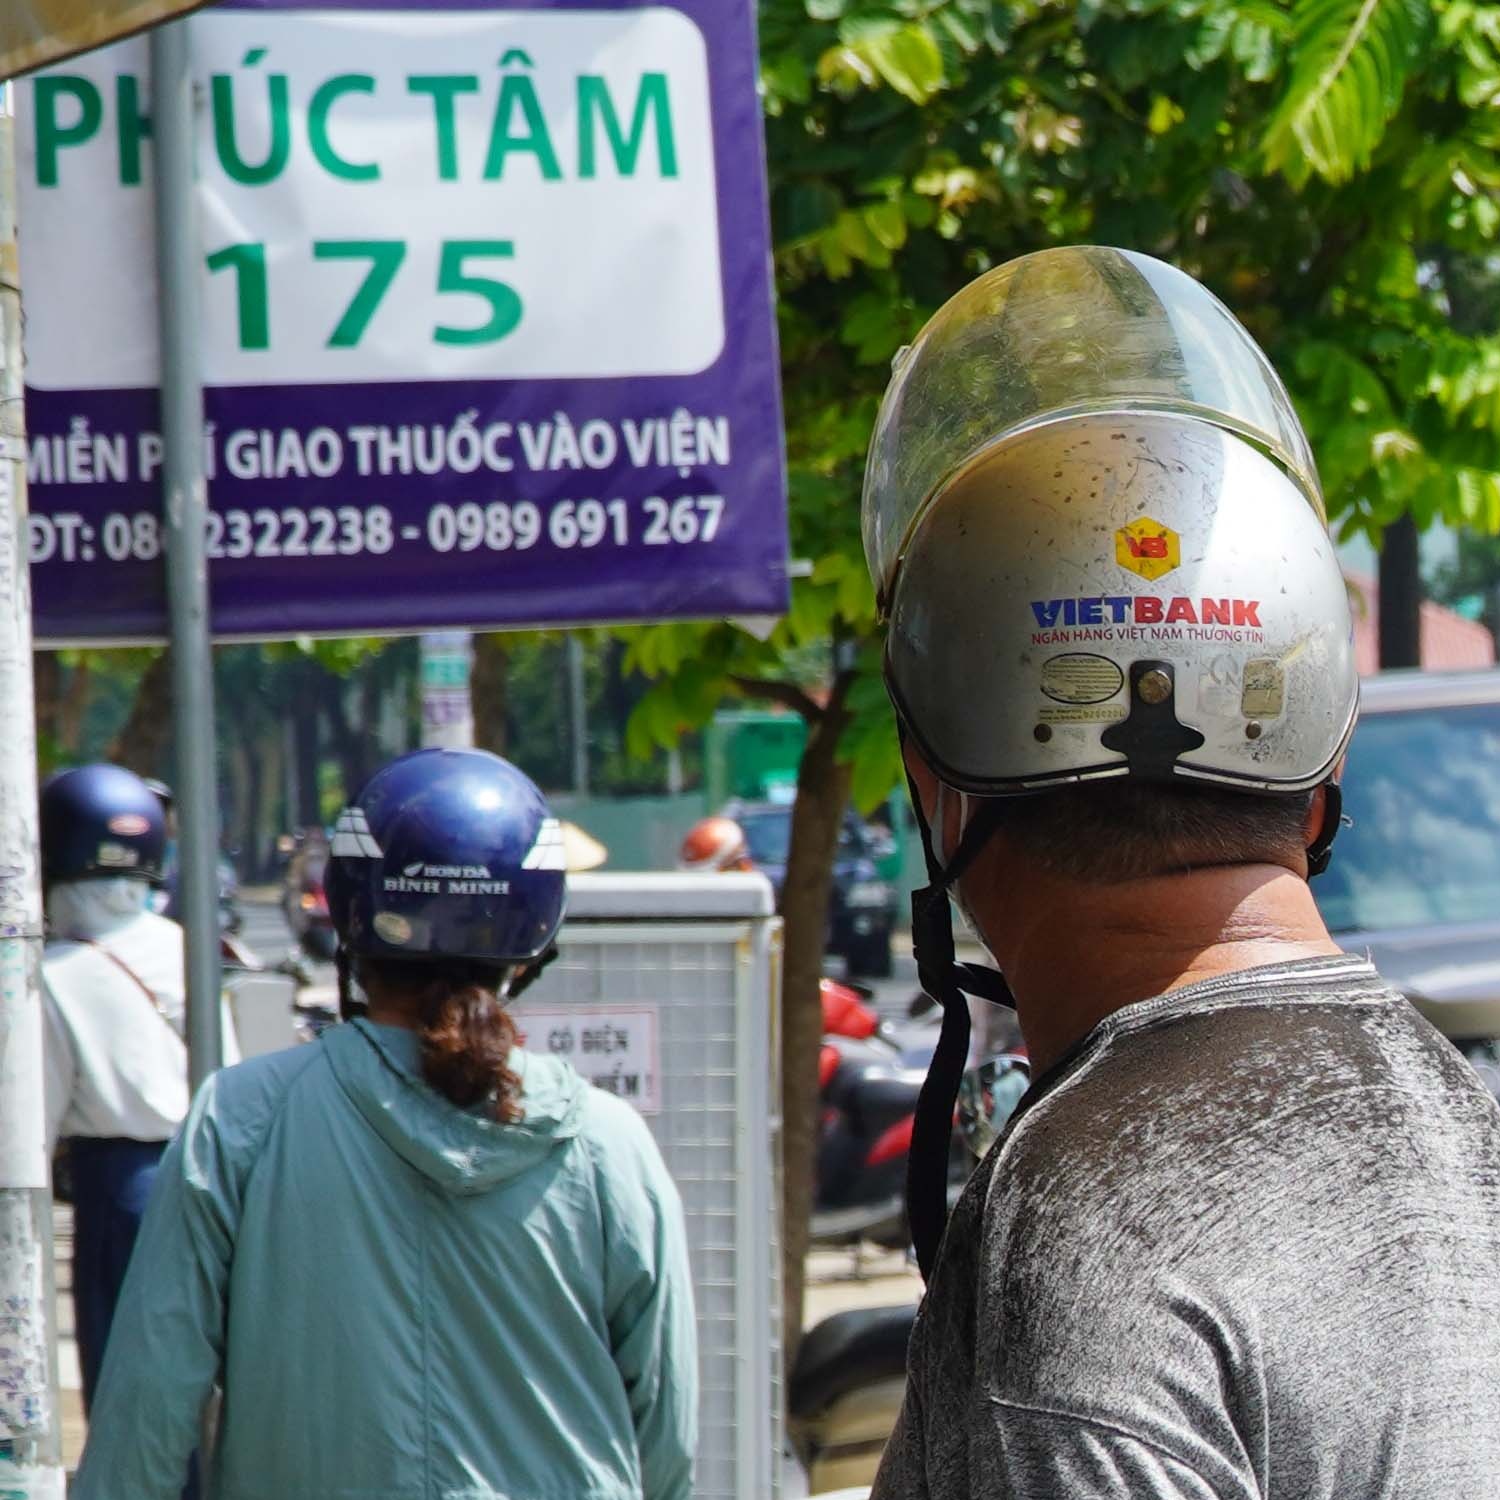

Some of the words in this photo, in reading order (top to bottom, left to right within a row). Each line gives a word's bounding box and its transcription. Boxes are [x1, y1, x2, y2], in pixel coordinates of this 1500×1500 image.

[406, 50, 679, 182] TÂM
[206, 240, 524, 351] 175
[138, 421, 216, 482] PÍ
[225, 427, 344, 479] GIAO
[347, 408, 514, 476] THUỐC
[517, 410, 617, 471] VÀO
[621, 406, 730, 478] VIỆN
[427, 501, 541, 552] 0989
[550, 498, 628, 548] 691
[642, 495, 725, 545] 267
[1030, 596, 1262, 628] VIETBANK
[1032, 629, 1070, 645] NGÂN
[1073, 627, 1113, 641] HÀNG
[1151, 628, 1182, 640] NAM
[1187, 626, 1242, 642] THƯƠNG
[383, 876, 441, 894] BÌNH
[447, 881, 510, 895] MINH
[424, 864, 492, 879] HONDA
